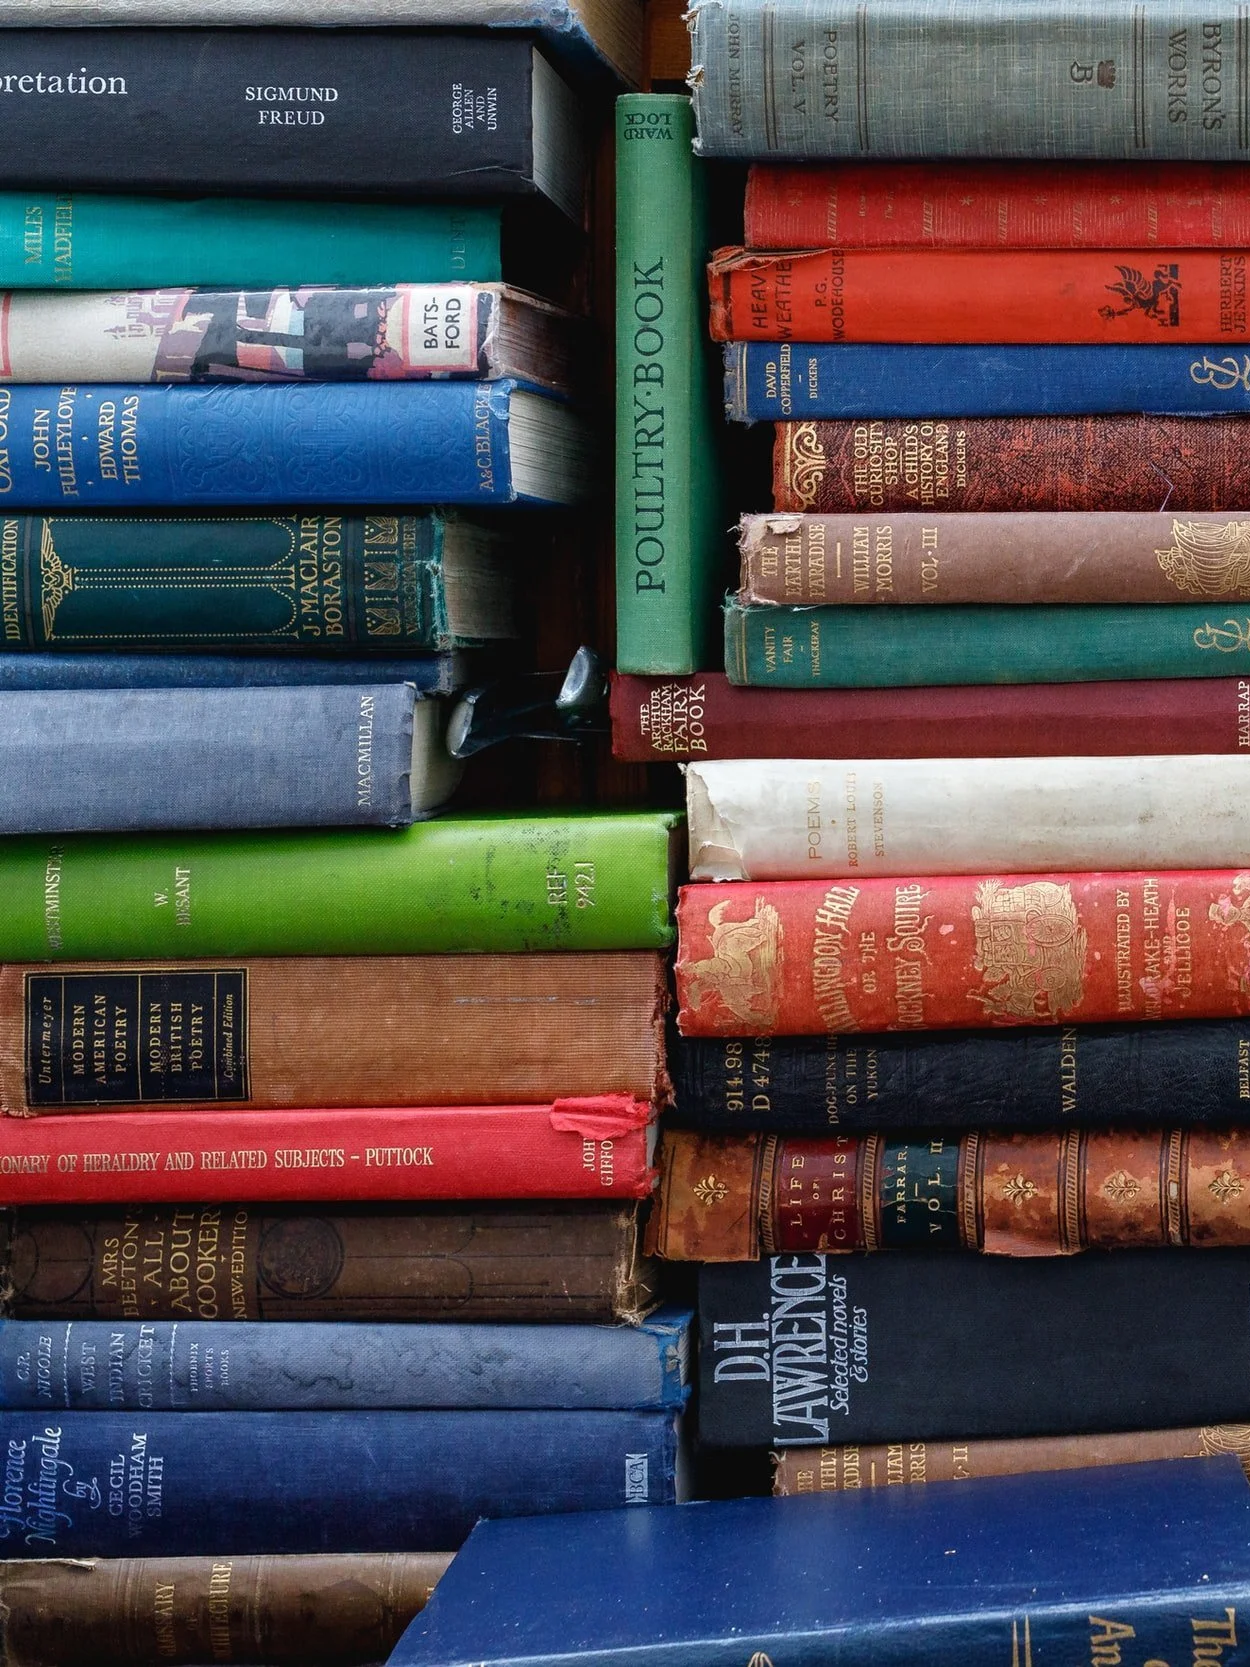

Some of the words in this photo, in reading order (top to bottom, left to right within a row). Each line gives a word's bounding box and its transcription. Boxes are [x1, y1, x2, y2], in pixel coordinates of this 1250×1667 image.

[729, 13, 741, 67] JOHN
[245, 87, 339, 103] SIGMUND
[452, 83, 463, 134] GEORGE
[466, 89, 475, 129] ALLEN
[488, 88, 498, 131] UNWIN
[731, 70, 744, 138] MURRAY
[823, 30, 838, 124] POETRY
[1167, 28, 1187, 124] WORKS
[1203, 22, 1222, 131] BYRON'S
[258, 111, 325, 126] FREUD
[624, 128, 673, 140] WARD
[625, 113, 672, 126] LOCK
[24, 206, 43, 265] MILES
[446, 298, 461, 349] FORD
[1220, 255, 1233, 333] HERBERT
[1233, 255, 1246, 334] JENKINS
[766, 361, 777, 399] DAVID
[780, 344, 791, 416] COPPERFIELD
[809, 358, 817, 399] DICKENS
[34, 408, 51, 472] JOHN
[57, 386, 78, 497] FULLEYLOVE
[98, 401, 117, 480] EDWARD
[120, 395, 141, 484] THOMAS
[854, 426, 869, 460] OLD
[870, 421, 884, 506] CURIOSITY
[885, 436, 898, 486] SHOP
[936, 423, 950, 498] ENGLAND
[956, 430, 966, 488] DICKENS
[921, 440, 935, 507] HISTORY
[1, 520, 21, 640] IDENTIFICATION
[324, 517, 344, 637] BORASTON
[761, 545, 779, 577] THE
[809, 523, 826, 598] PARADISE
[853, 525, 870, 593] WILLIAM
[876, 525, 893, 593] MORRIS
[766, 627, 776, 673] VANITY
[783, 635, 793, 664] FAIR
[811, 621, 821, 677] THACKERAY
[640, 703, 650, 736] THE
[650, 688, 662, 751] ARTHUR
[663, 683, 674, 753] RACKHAM
[673, 683, 689, 753] FAIRY
[690, 683, 708, 753] BOOK
[1239, 680, 1250, 747] HARRAP
[358, 695, 375, 806] MACMILLAN
[1116, 888, 1130, 911] BY
[1117, 913, 1131, 1013] ILLUSTRATED
[1174, 907, 1191, 998] JELLICOE
[74, 1004, 86, 1075] MODERN
[94, 994, 107, 1083] AMERICAN
[116, 1005, 127, 1073] POETRY
[151, 1002, 163, 1073] MODERN
[171, 1002, 183, 1073] BRITISH
[192, 1004, 203, 1071] POETRY
[225, 993, 234, 1035] Edition
[223, 1038, 234, 1080] Combined
[725, 1041, 744, 1112] 914.98
[1062, 1028, 1078, 1113] WALDEN
[1239, 1040, 1250, 1099] BELFAST
[58, 1155, 77, 1173] OF
[83, 1152, 160, 1173] HERALDRY
[165, 1151, 194, 1171] AND
[200, 1150, 267, 1170] RELATED
[275, 1148, 345, 1168] SUBJECTS
[365, 1147, 433, 1166] PUTTOCK
[791, 1154, 805, 1226] LIFE
[832, 1137, 848, 1240] CHRIST
[102, 1237, 119, 1287] MRS
[143, 1231, 163, 1288] ALL
[170, 1211, 195, 1312] ABOUT
[830, 1274, 847, 1336] novels
[850, 1306, 868, 1365] stories
[38, 1336, 52, 1397] NICOLE
[82, 1342, 96, 1395] WEST
[109, 1332, 125, 1402] INDIAN
[139, 1324, 156, 1409] CRICKET
[714, 1312, 770, 1384] D.H.
[770, 1254, 830, 1446] LAWRENCE
[829, 1337, 849, 1415] Selected
[109, 1453, 125, 1516] CECIL
[147, 1455, 164, 1517] SMITH
